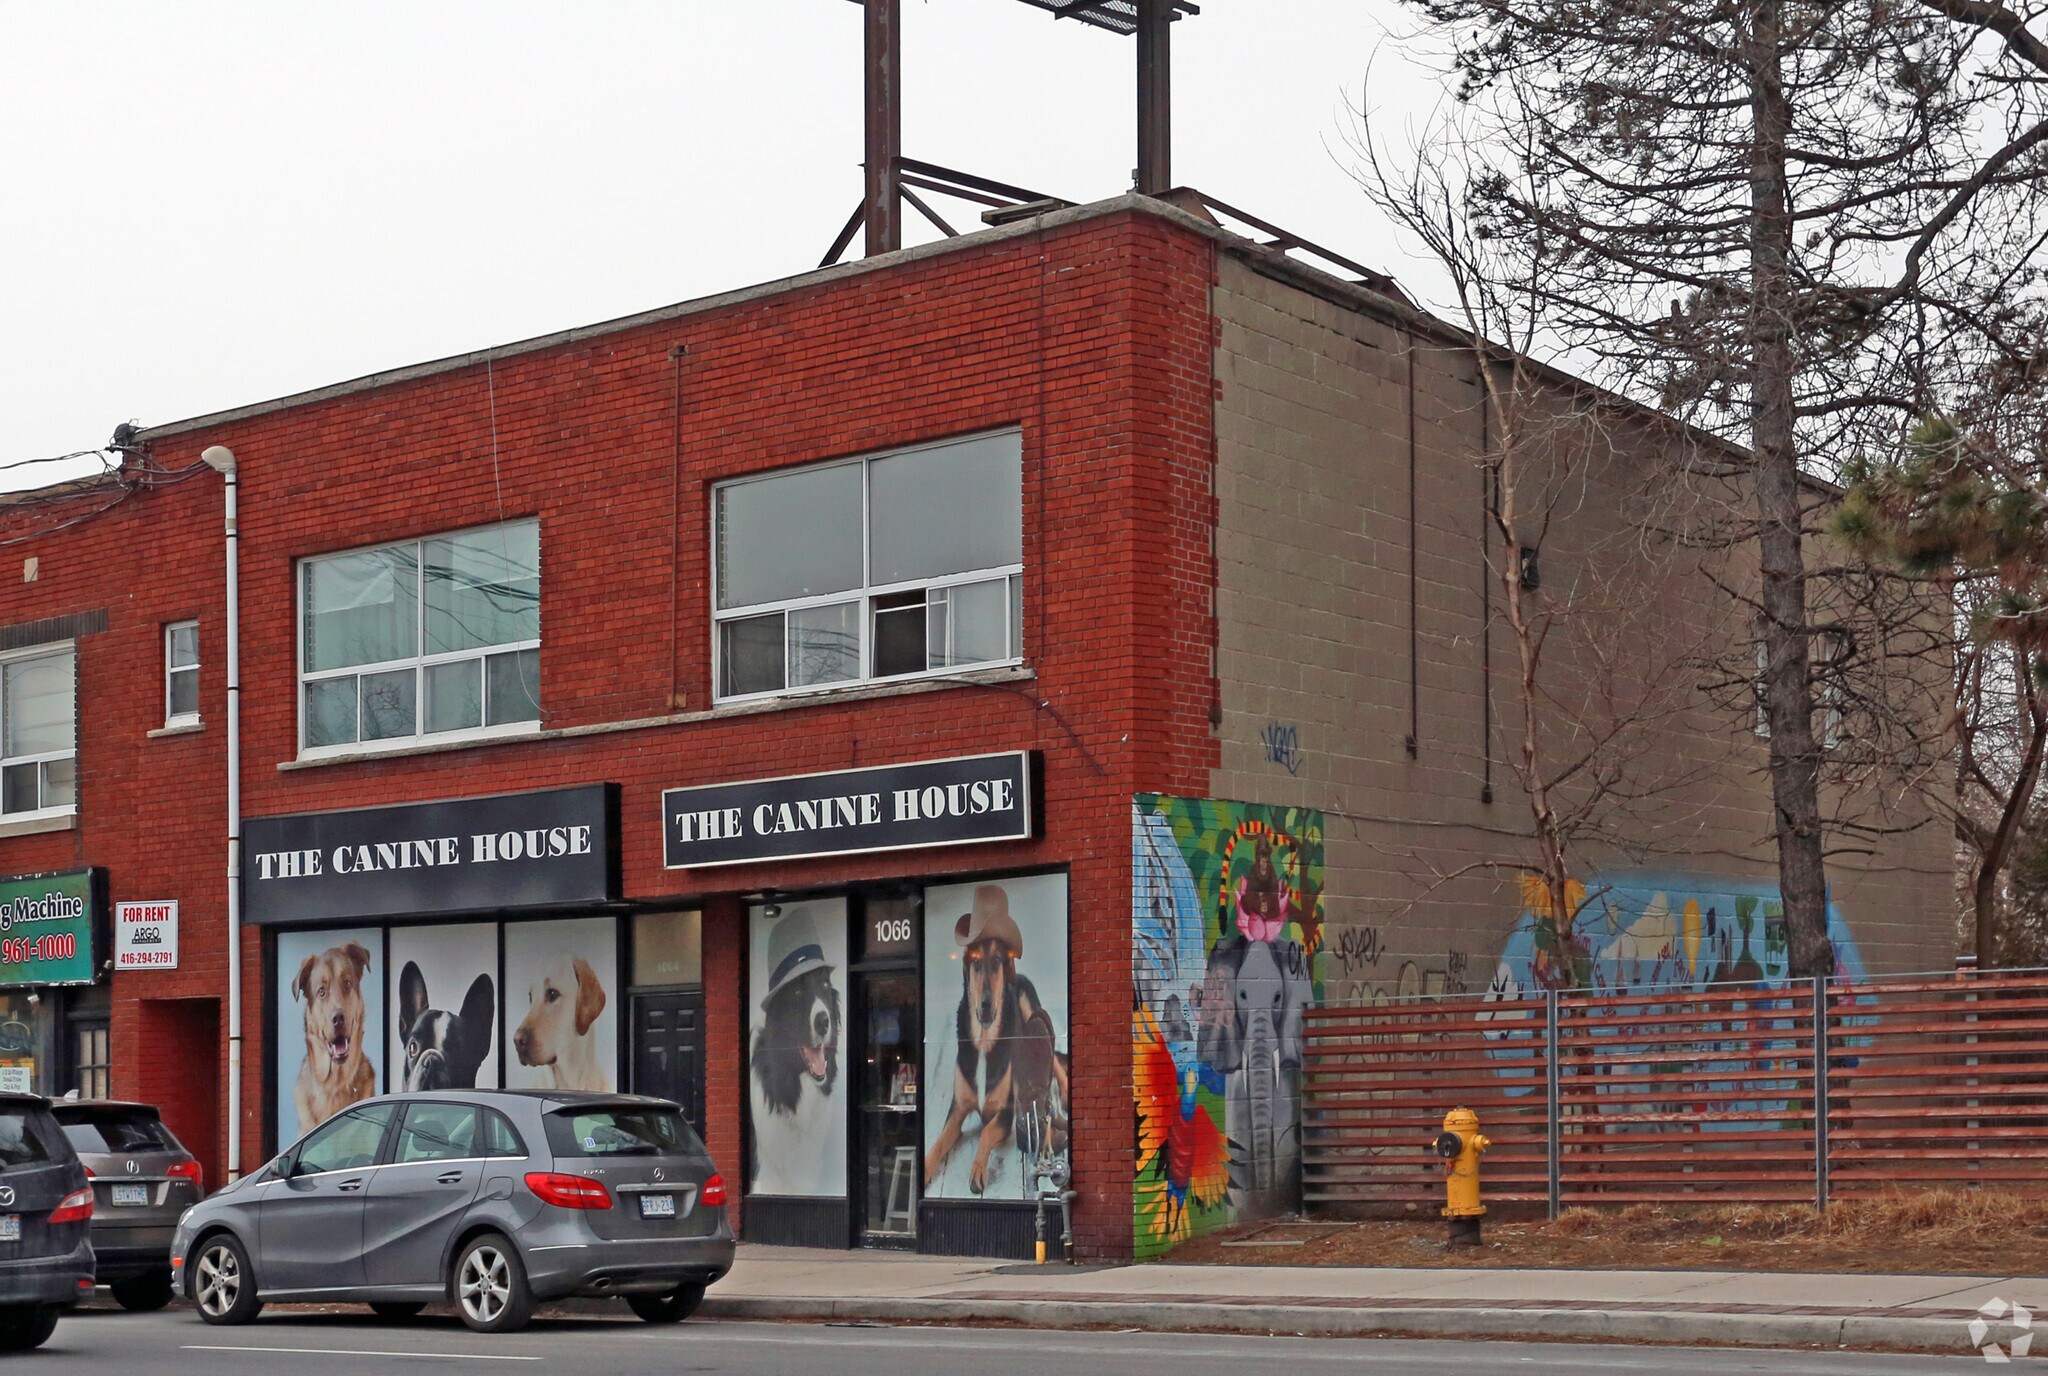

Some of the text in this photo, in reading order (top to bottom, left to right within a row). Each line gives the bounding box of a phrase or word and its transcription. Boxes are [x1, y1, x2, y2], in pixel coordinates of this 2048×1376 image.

[676, 778, 1014, 843] THE CANINE HOUSE
[255, 825, 592, 880] THE CANINE HOUSE
[14, 892, 83, 922] Machine
[123, 906, 170, 922] FOR RENT
[133, 927, 160, 940] ARGO
[874, 918, 911, 942] 1066
[2, 933, 77, 964] 961-1000
[120, 952, 172, 964] 416-294-2791
